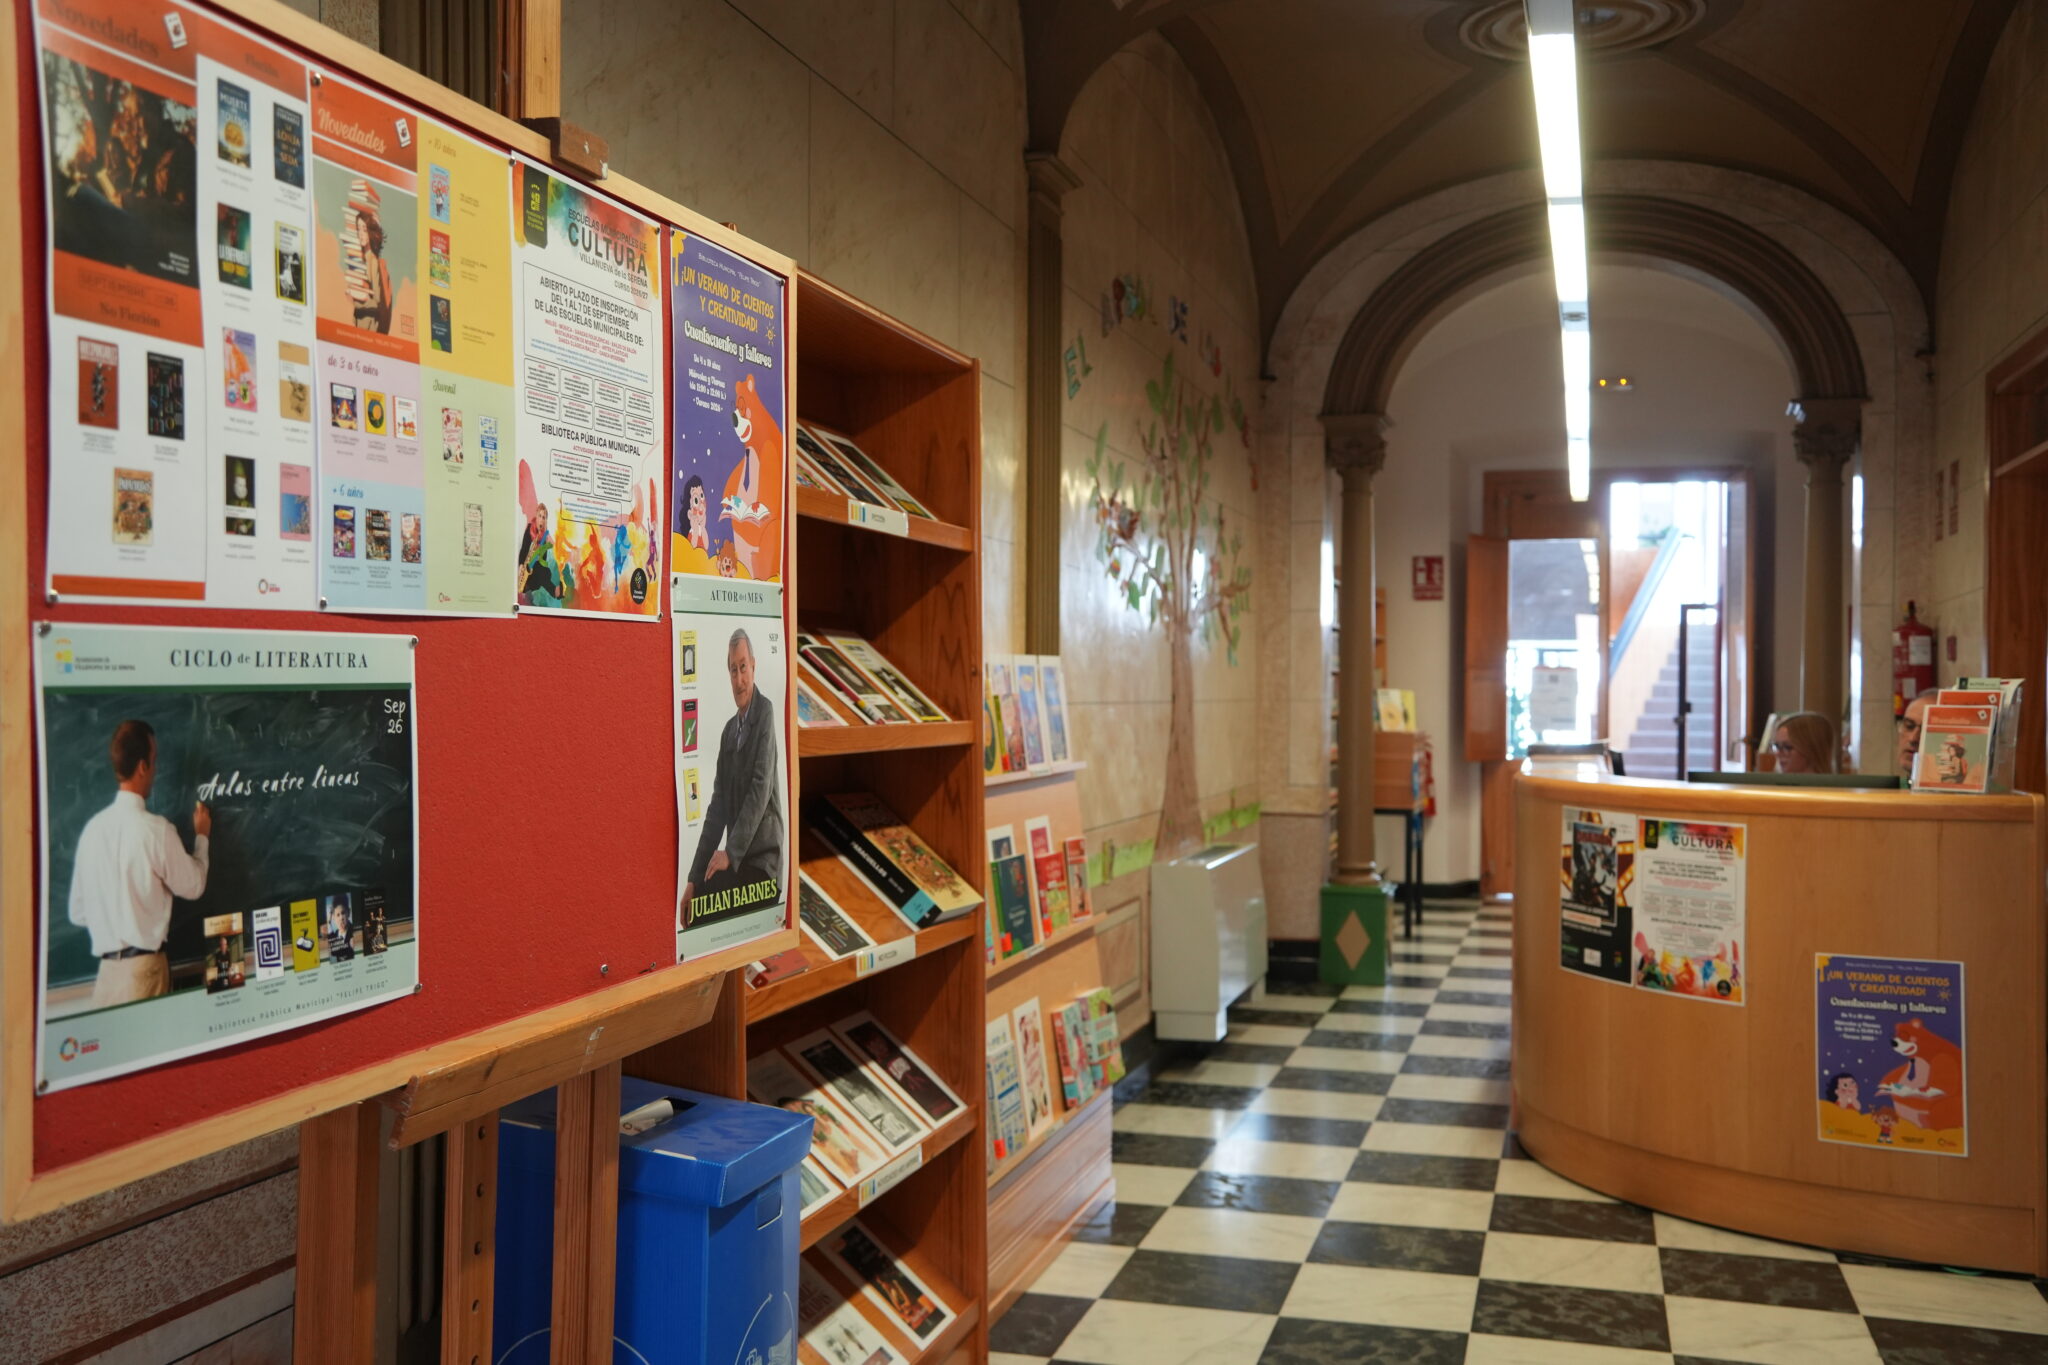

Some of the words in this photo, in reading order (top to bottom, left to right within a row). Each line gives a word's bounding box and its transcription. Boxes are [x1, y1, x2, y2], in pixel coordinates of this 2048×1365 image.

[318, 108, 386, 154] Novedades
[568, 208, 600, 230] ESCUELAS
[600, 223, 639, 248] MUNICIPALES
[568, 222, 648, 277] CULTURA
[580, 253, 614, 274] VILLANUEVA
[627, 272, 648, 288] SERENA
[540, 276, 569, 295] ABIERTO
[569, 287, 590, 303] PLAZO
[591, 295, 600, 306] DE
[600, 298, 638, 321] INSCRIPCIÓN
[614, 280, 630, 293] CURSO
[681, 265, 696, 286] ¡UN
[697, 272, 729, 300] VERANO
[731, 287, 741, 305] DE
[743, 293, 775, 319] CUENTOS
[534, 299, 544, 310] DE
[545, 302, 558, 315] LAS
[559, 308, 593, 329] ESCUELAS
[593, 322, 634, 343] MUNICIPALES
[634, 336, 645, 347] DE:
[551, 293, 564, 306] DEL
[568, 299, 578, 310] AL
[583, 305, 591, 315] DE
[592, 308, 630, 330] SEPTIEMBRE
[700, 295, 706, 312] Y
[708, 299, 758, 333] CREATIVIDAD!
[684, 320, 738, 356] Cuentacuentos
[739, 344, 745, 362] y
[745, 343, 773, 368] talleres
[327, 354, 337, 367] de
[362, 364, 379, 377] años
[433, 379, 456, 395] Juvenil
[542, 423, 579, 442] BIBLIOTECA
[580, 432, 607, 448] PÚBLICA
[608, 441, 641, 456] MUNICIPAL
[346, 486, 364, 499] años
[711, 590, 739, 603] AUTOR
[747, 592, 764, 604] MES
[768, 633, 778, 642] SEP
[170, 648, 232, 668] CICLO
[237, 652, 250, 664] de
[255, 651, 369, 669] LITERATURA
[384, 698, 405, 717] Sep
[387, 718, 403, 734] 26
[198, 770, 252, 801] Aulas
[262, 771, 305, 793] entre
[1671, 835, 1734, 851] CULTURA
[689, 889, 731, 924] JULIAN
[733, 878, 777, 910] BARNES
[1846, 971, 1886, 983] VERANO
[1889, 974, 1901, 983] DE
[1904, 975, 1950, 986] CUENTOS
[1850, 982, 1857, 992] Y
[1860, 983, 1926, 997] CREATIVIDAD!
[209, 1017, 256, 1033] Biblioteca
[260, 1006, 292, 1020] Pública
[296, 994, 334, 1011] Municipal
[1909, 1002, 1947, 1014] talleres
